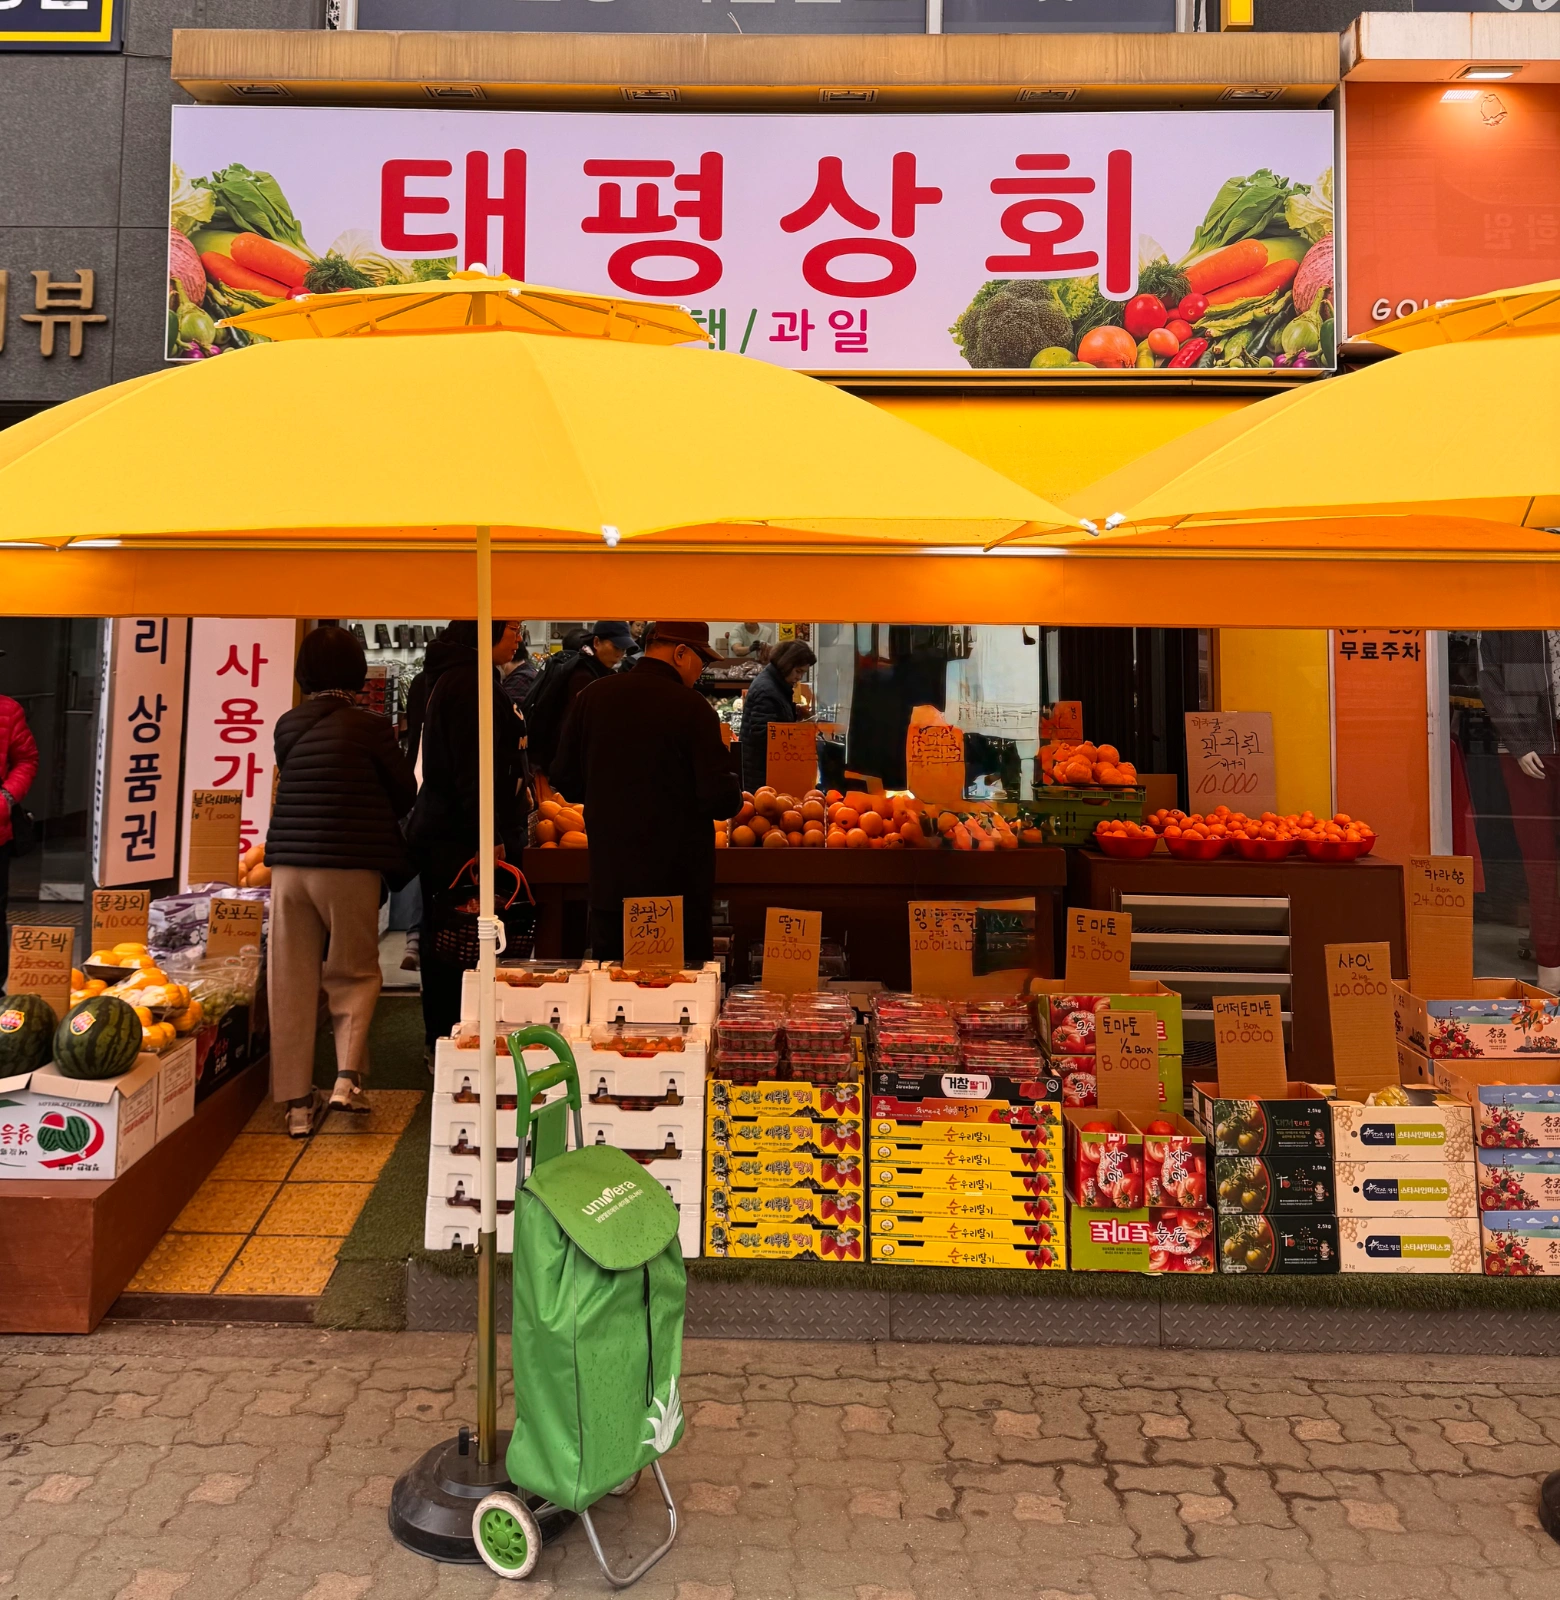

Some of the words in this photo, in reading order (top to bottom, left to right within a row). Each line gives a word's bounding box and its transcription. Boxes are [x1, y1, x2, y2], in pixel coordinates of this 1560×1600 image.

[769, 308, 868, 353] 과일
[1339, 641, 1421, 661] 무료주차
[121, 693, 168, 863] 상품권
[1195, 772, 1259, 794] 10.000
[205, 807, 236, 821] 7.000
[1424, 868, 1465, 885] 카라향
[96, 893, 146, 912] 꿀참외
[1413, 892, 1465, 907] 24.000
[214, 900, 259, 920] 청포도
[222, 922, 258, 937] 4.000
[778, 914, 807, 936] 딸기
[1076, 914, 1117, 936] 토마토
[14, 929, 68, 952] 꿀수박
[766, 945, 812, 961] 10.000
[1070, 944, 1125, 962] 15.000
[1338, 953, 1374, 971] 샤인
[1333, 981, 1388, 996] 10.000
[1216, 1000, 1274, 1017] 대저토마토
[1102, 1016, 1140, 1036] 토마토
[1219, 1029, 1274, 1044] 10.000
[1101, 1054, 1151, 1071] 8.000
[581, 1180, 637, 1216] univera
[1089, 1219, 1150, 1243] 토마토
[1152, 1221, 1187, 1245] 완숙
